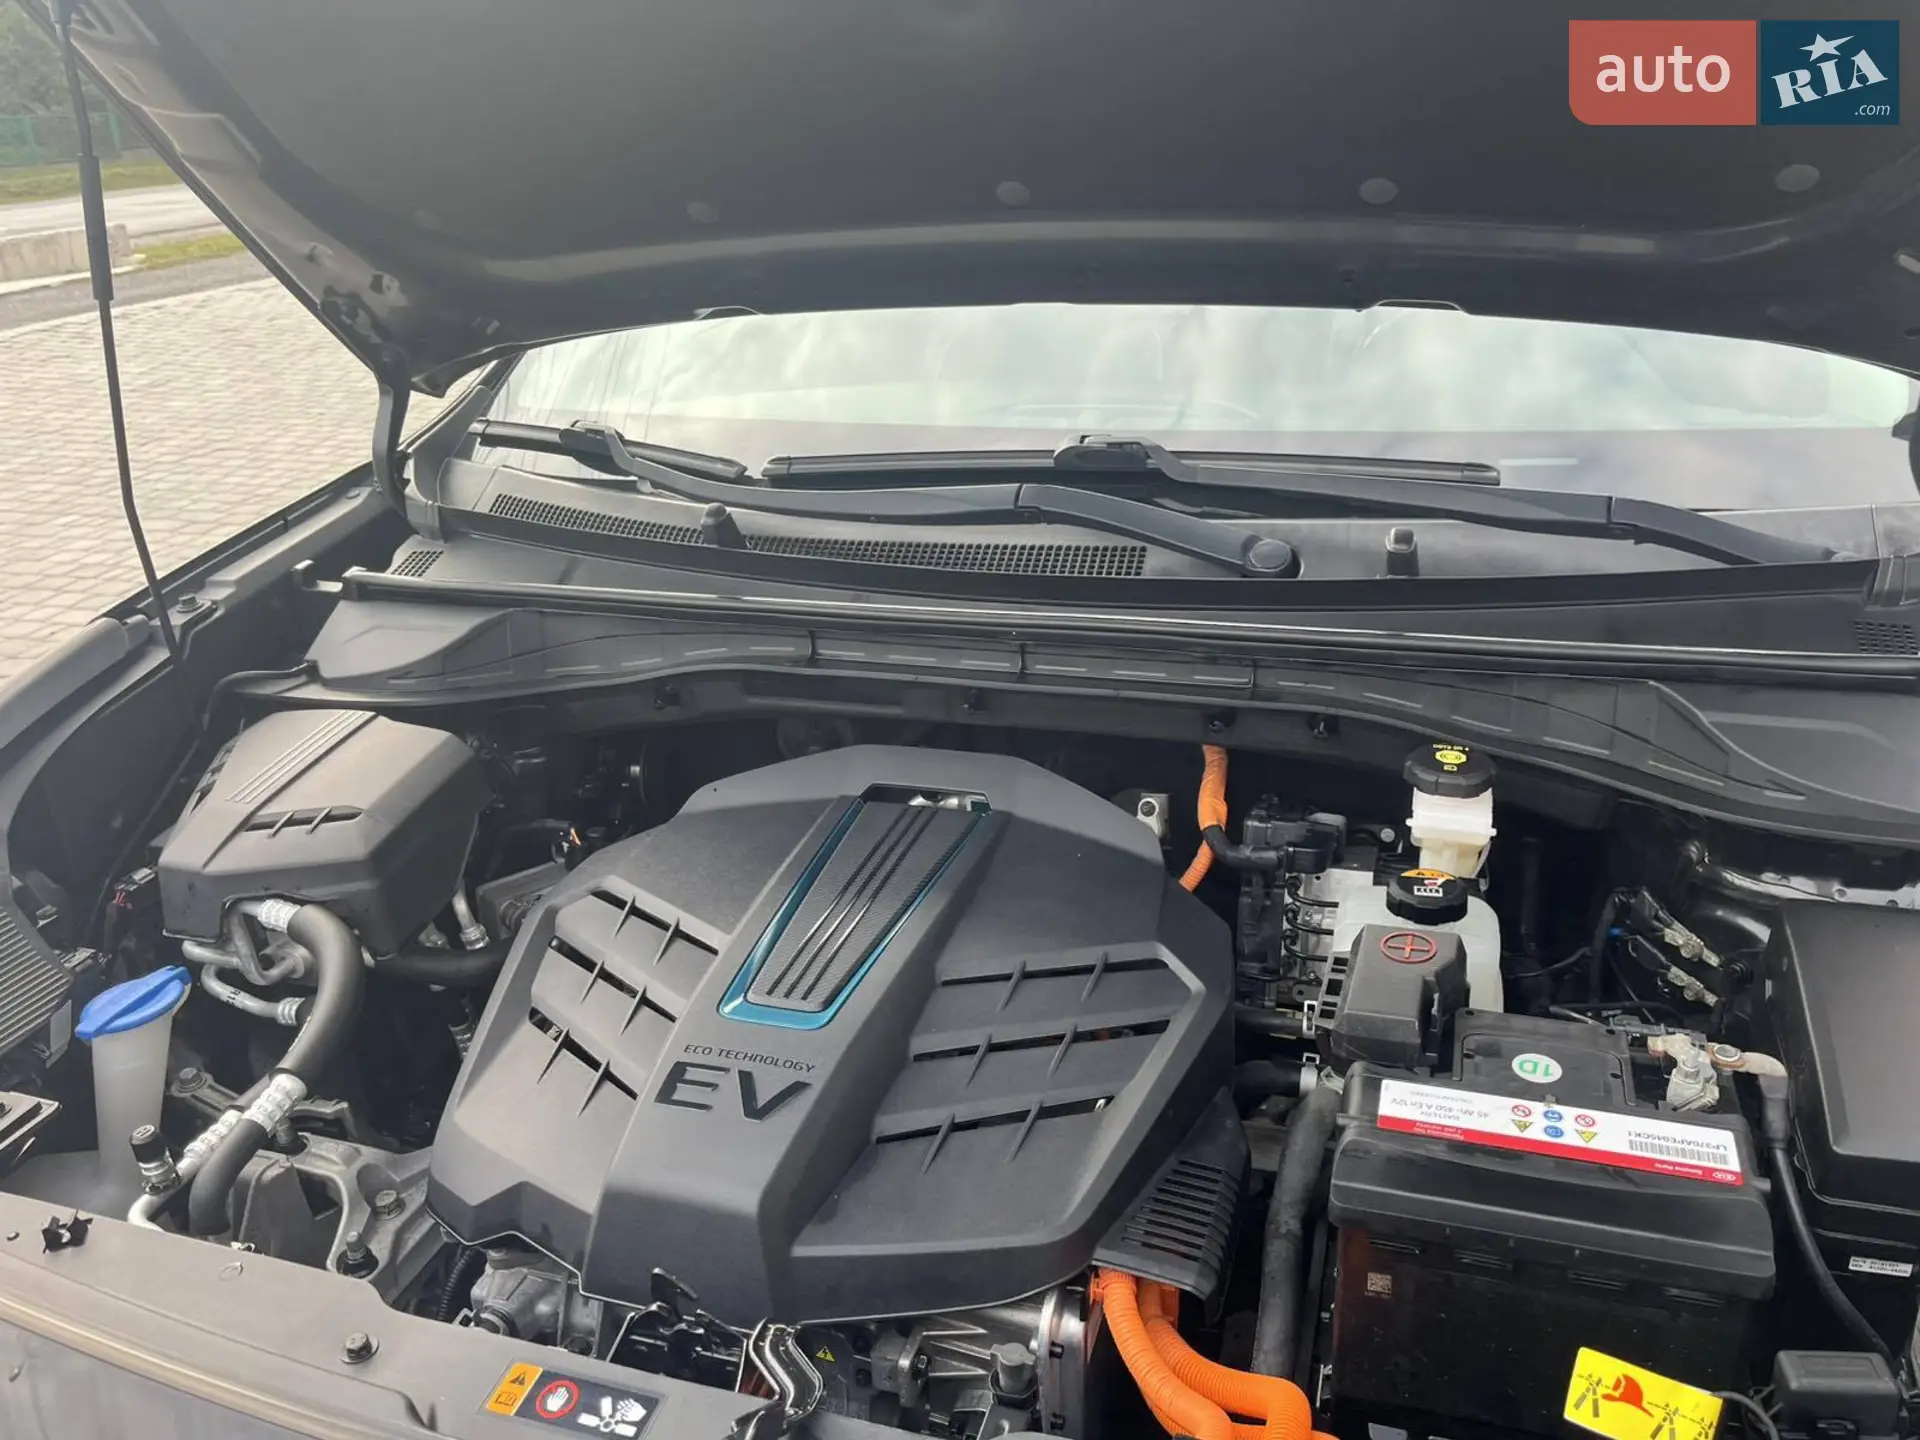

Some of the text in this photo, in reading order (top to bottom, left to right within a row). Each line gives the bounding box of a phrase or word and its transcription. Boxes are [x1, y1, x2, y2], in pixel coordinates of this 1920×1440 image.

[684, 1044, 817, 1073] ECO TECHNOLOGY
[1520, 1060, 1553, 1077] 1D
[654, 1061, 813, 1121] EV
